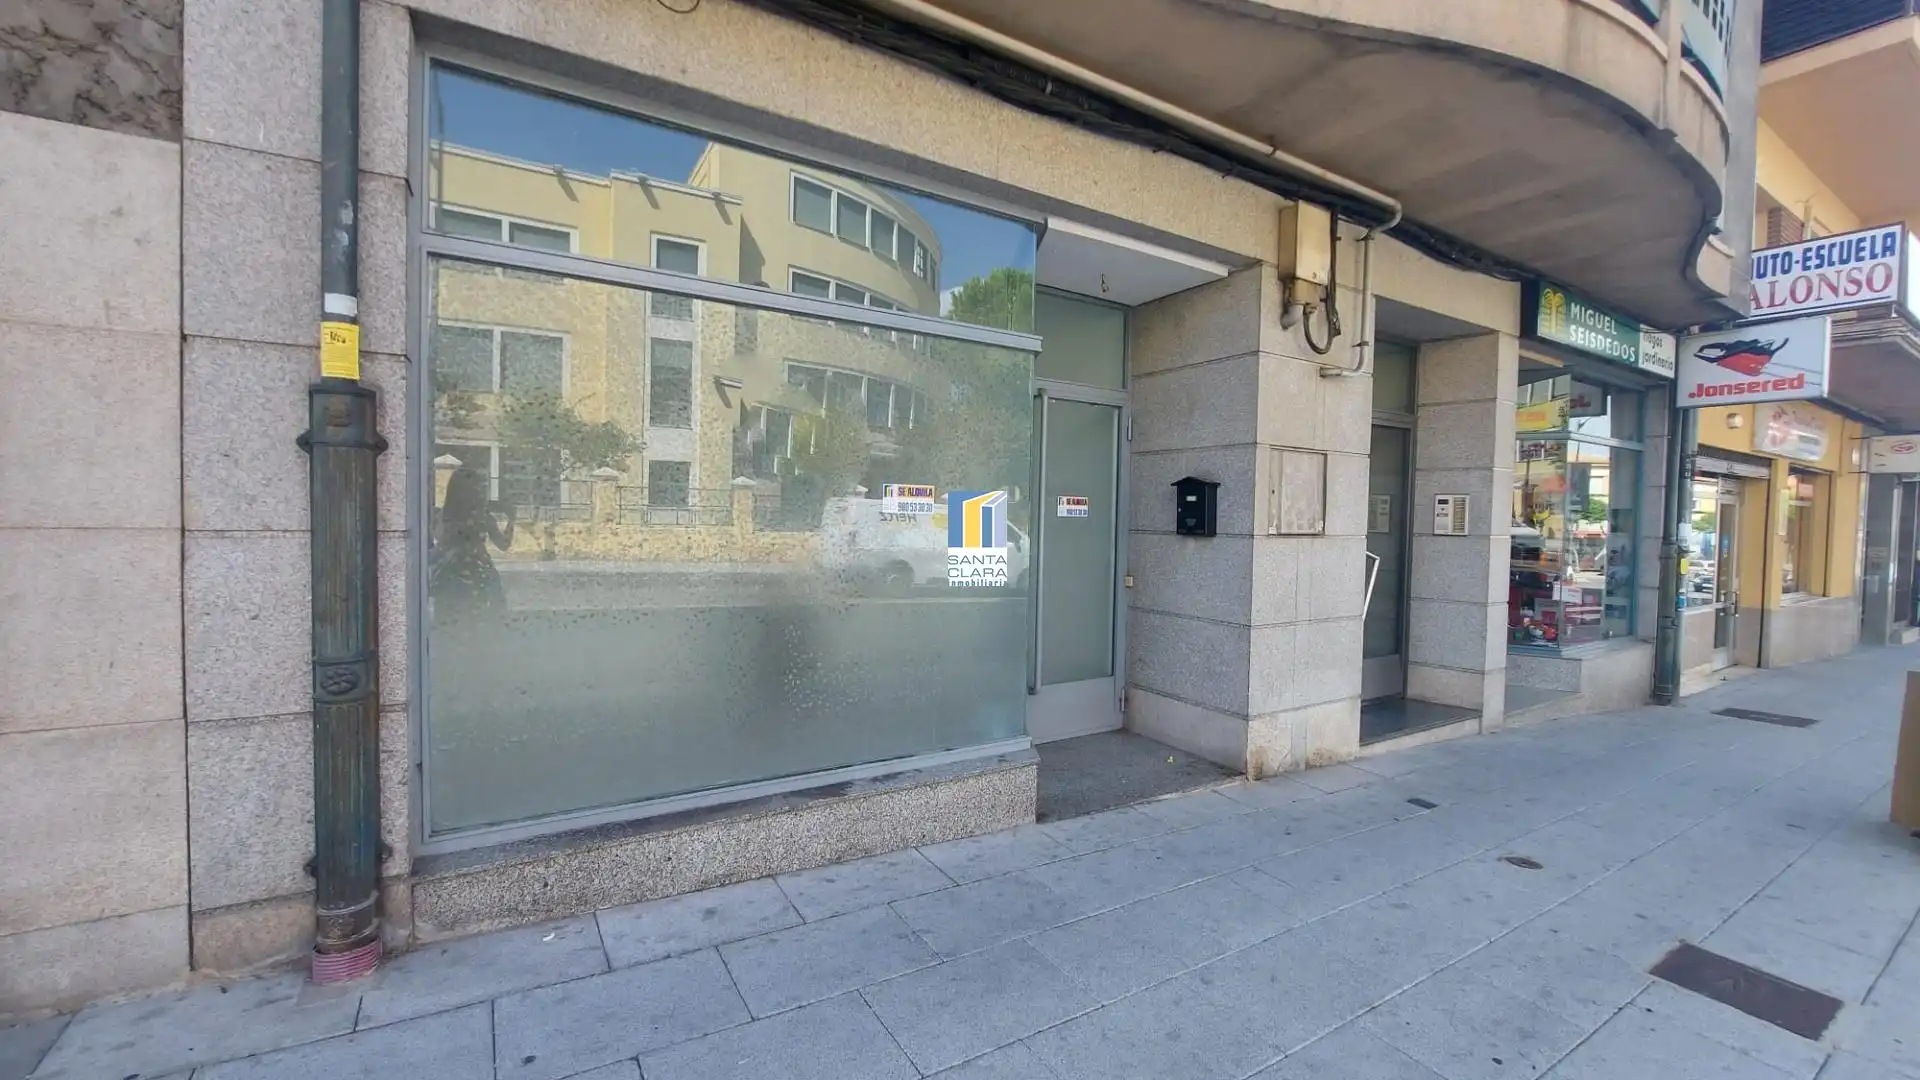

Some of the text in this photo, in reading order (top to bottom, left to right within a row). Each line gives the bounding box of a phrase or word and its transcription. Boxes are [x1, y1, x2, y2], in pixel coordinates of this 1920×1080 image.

[1750, 231, 1897, 280] UTO-ESCUELA
[1750, 262, 1893, 310] ALONSO
[1570, 302, 1618, 336] MIGUEL
[1569, 324, 1636, 363] SEISDEDOS
[1688, 373, 1805, 399] Jonsered
[898, 486, 933, 498] SE ALQUILA
